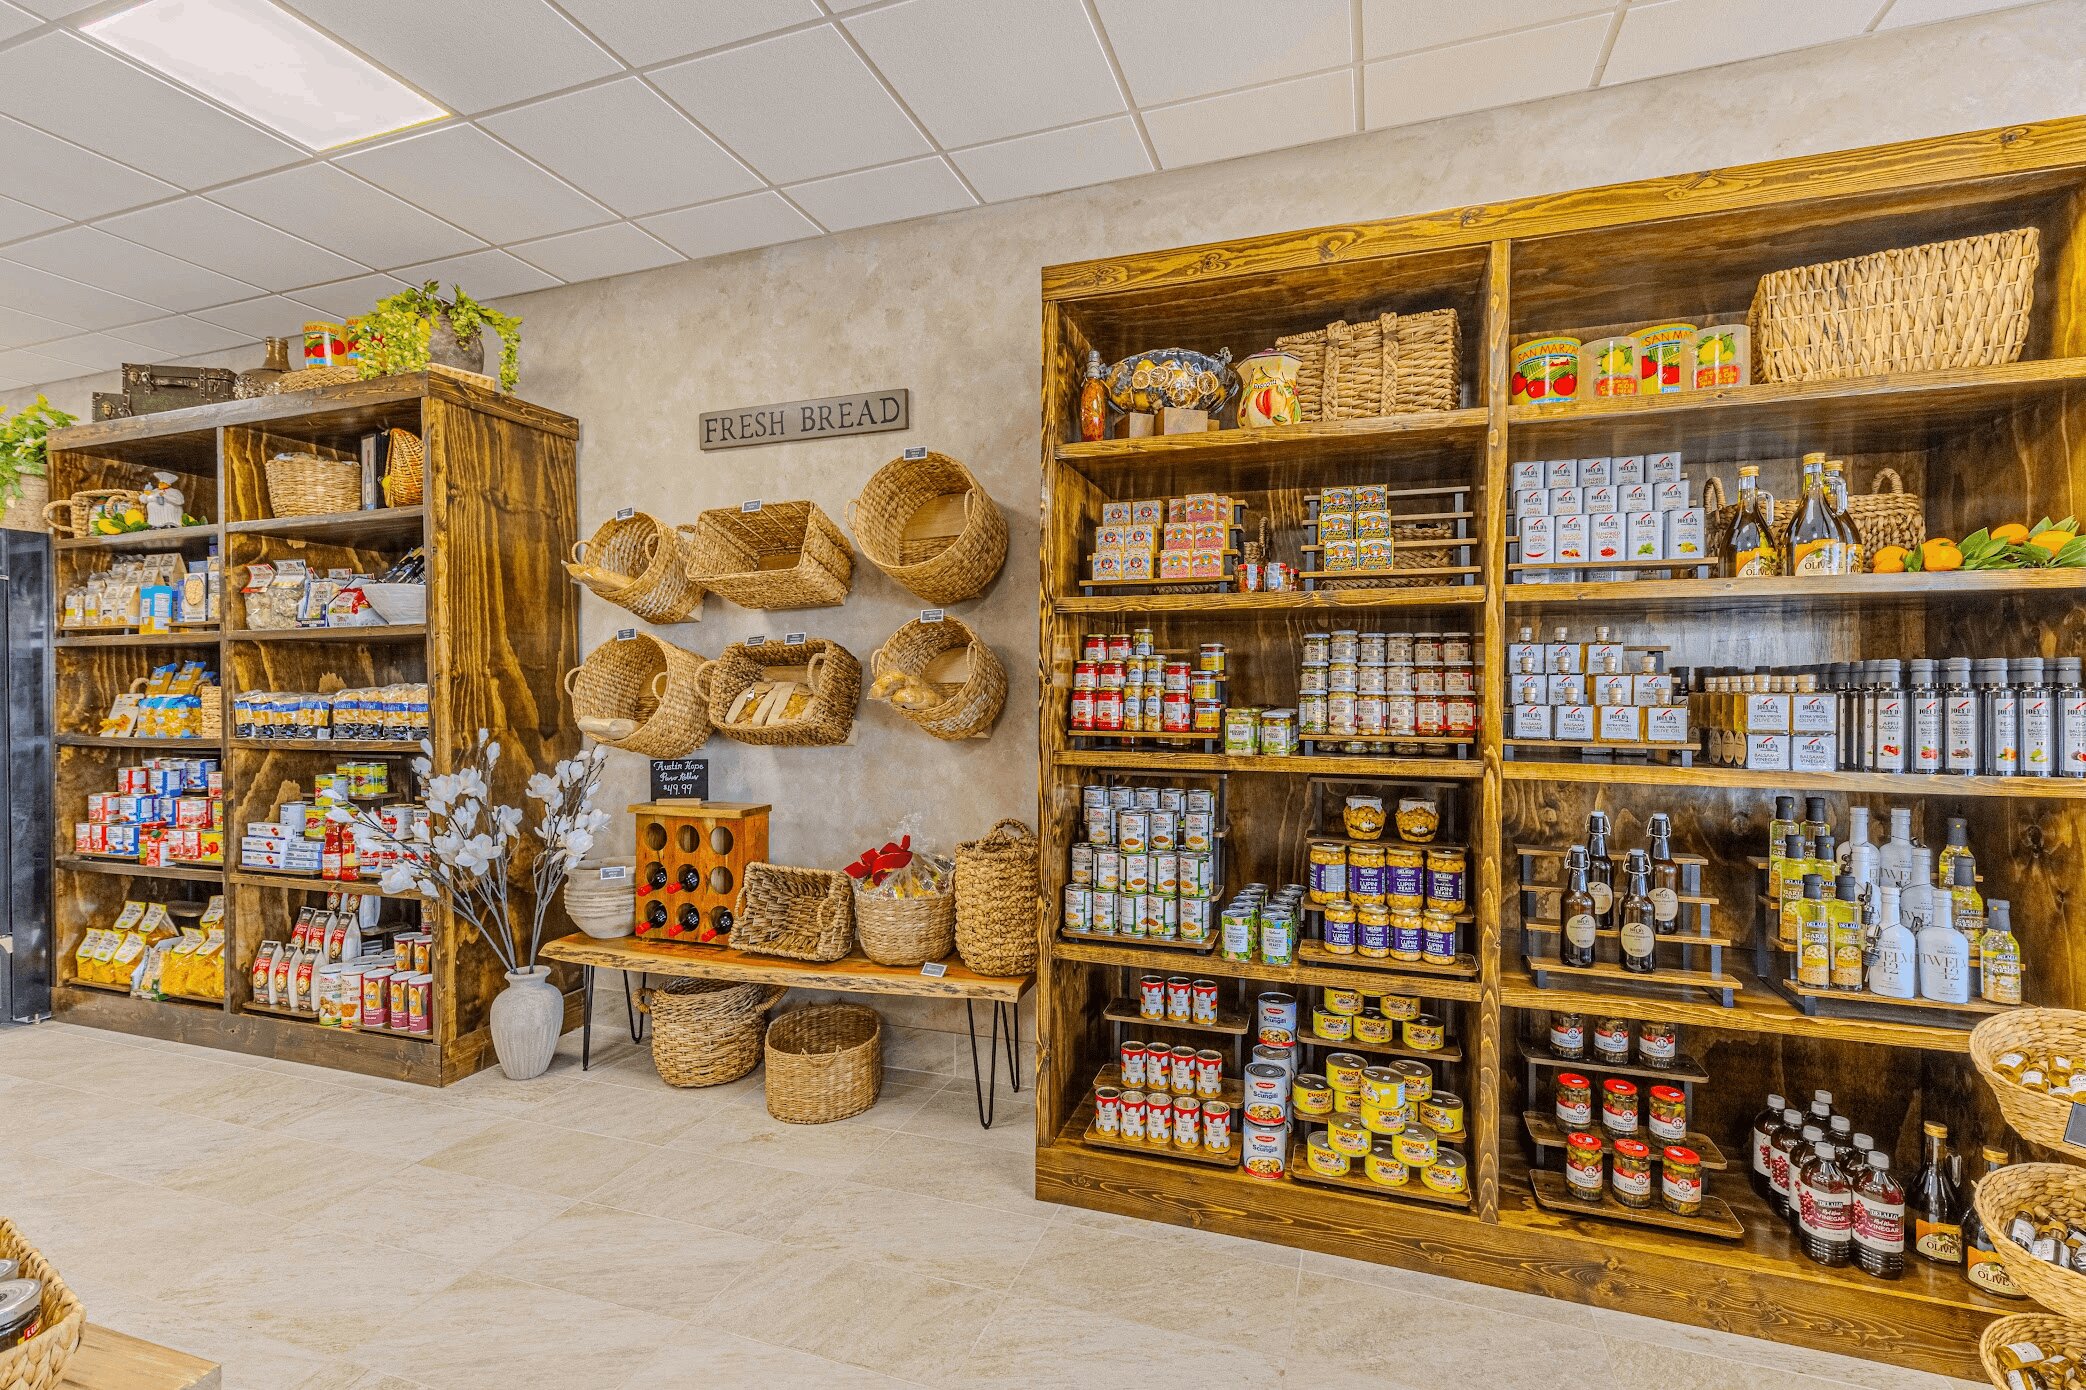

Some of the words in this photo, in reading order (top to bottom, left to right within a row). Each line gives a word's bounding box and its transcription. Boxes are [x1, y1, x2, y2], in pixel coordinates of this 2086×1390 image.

[1644, 333, 1670, 346] SAN
[1517, 349, 1537, 362] SAN
[705, 410, 785, 443] FRESH
[801, 397, 900, 432] BREAD
[1804, 561, 1832, 569] OLIVE
[653, 761, 682, 771] Austin
[663, 784, 693, 795] $49.99
[1400, 938, 1417, 946] LUPINI
[1426, 941, 1444, 949] LUPINI
[1944, 969, 1960, 980] 12
[1816, 1213, 1846, 1222] VINEGAR
[1867, 1222, 1900, 1233] VINEGAR
[1926, 1241, 1956, 1254] OLIVE
[1978, 1270, 2010, 1287] OLIVE
